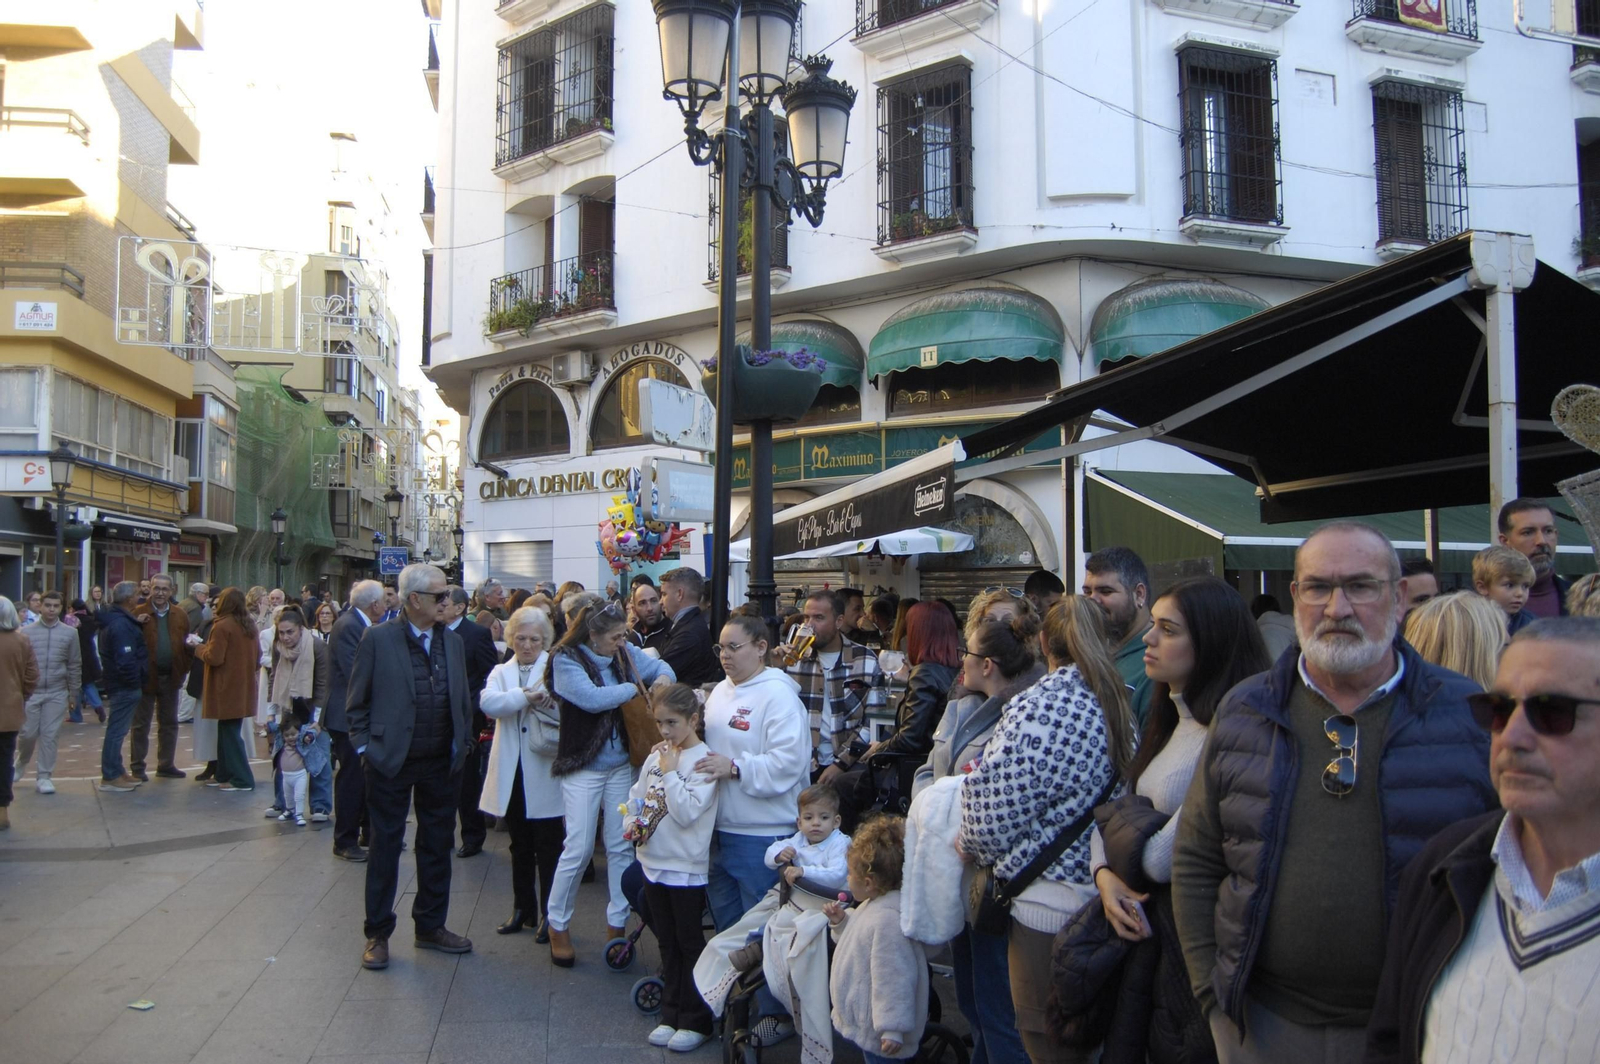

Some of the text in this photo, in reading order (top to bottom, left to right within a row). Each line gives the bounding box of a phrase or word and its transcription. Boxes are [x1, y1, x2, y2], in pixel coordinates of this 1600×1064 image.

[19, 312, 54, 321] AGMUR
[488, 364, 554, 399] Parra & Parr
[24, 462, 45, 475] Cs
[540, 471, 599, 495] DENTAL
[916, 487, 944, 508] Heineken
